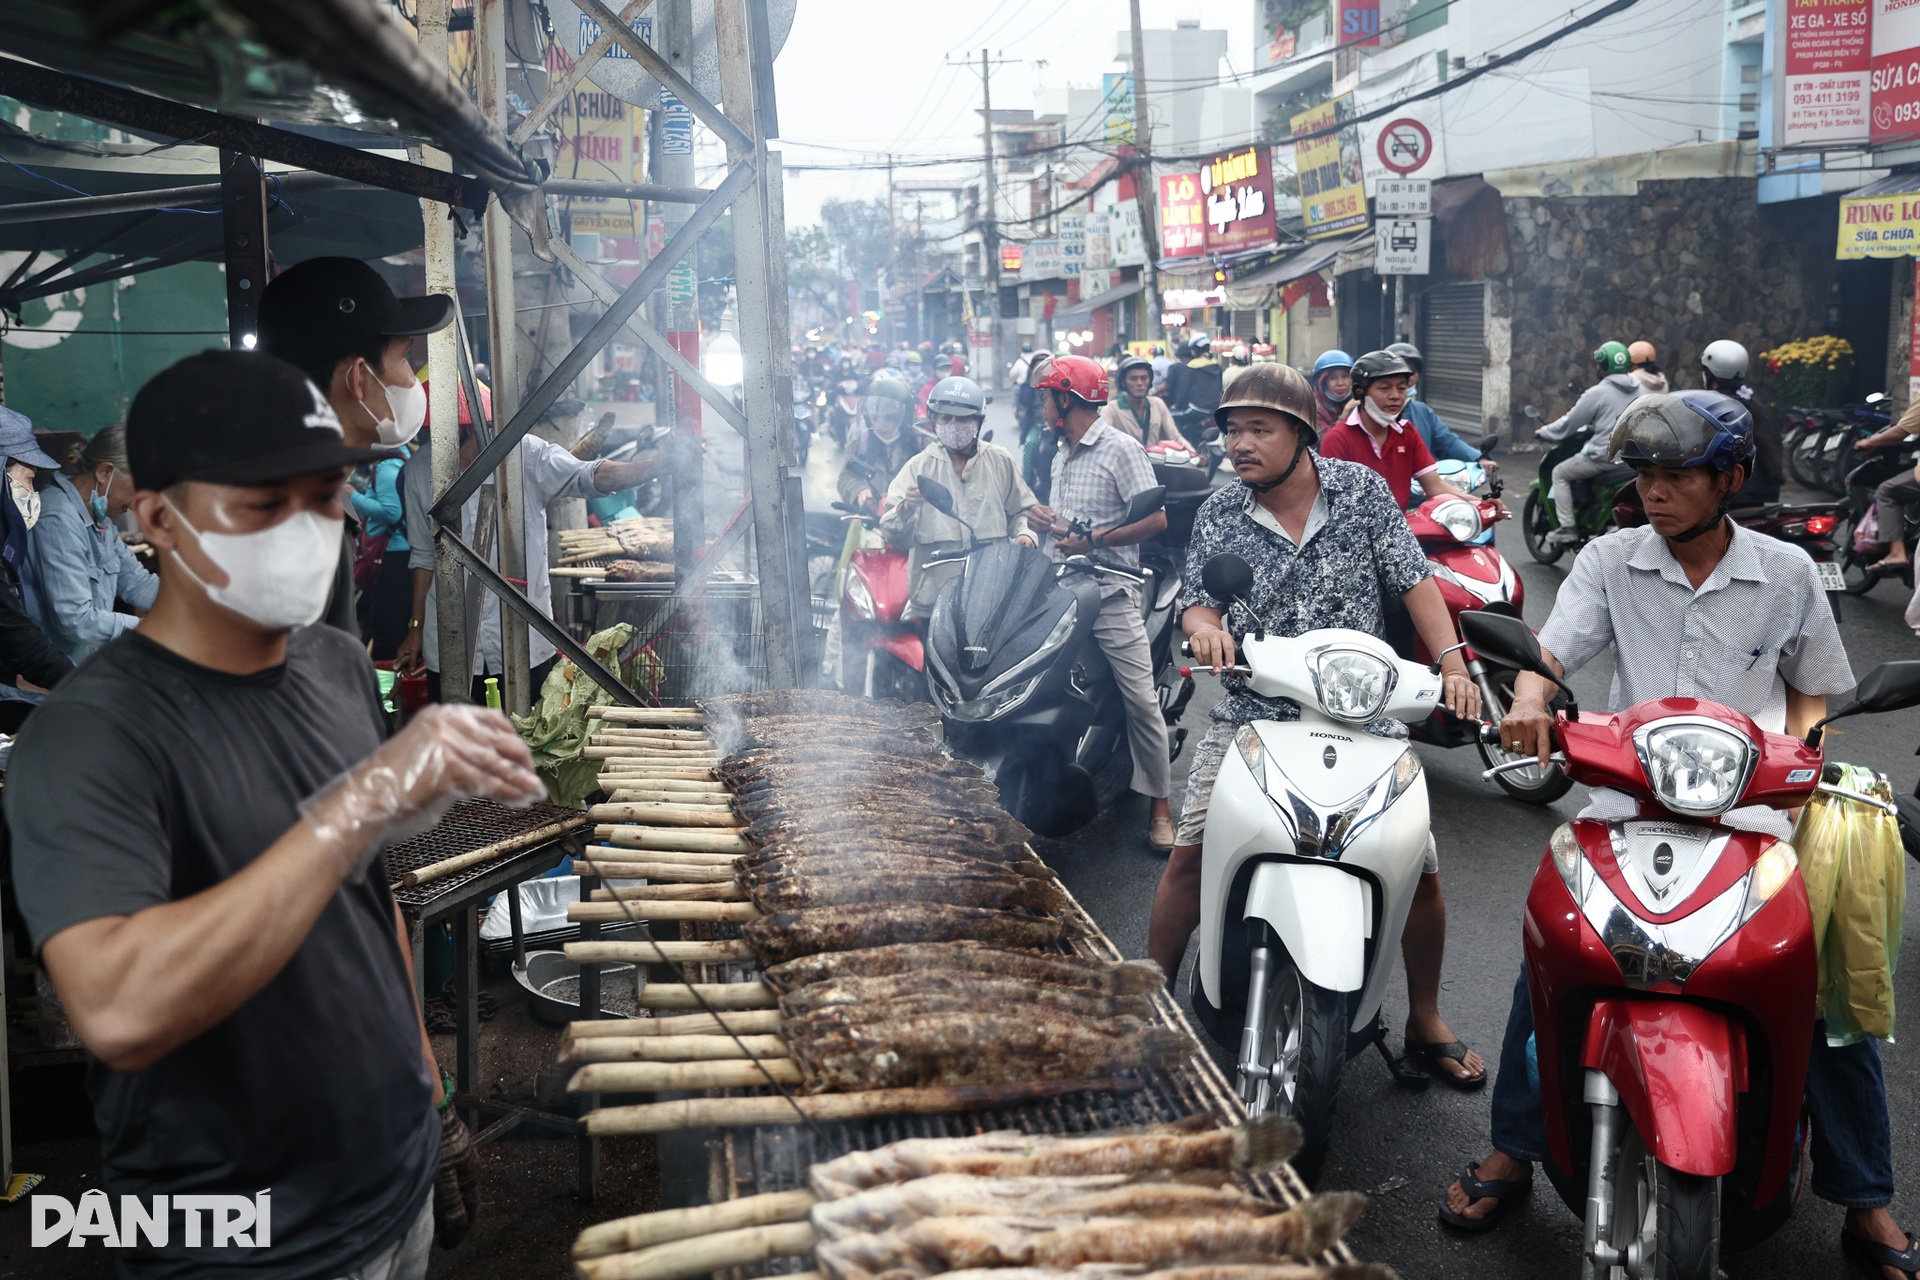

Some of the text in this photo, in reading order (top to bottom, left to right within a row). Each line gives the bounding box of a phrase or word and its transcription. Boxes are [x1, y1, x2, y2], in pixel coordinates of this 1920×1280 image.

[1791, 15, 1806, 29] XE
[1808, 14, 1825, 28] GA
[1833, 12, 1848, 27] XE
[1850, 6, 1867, 26] SỐ
[1793, 91, 1860, 105] 093 411 3199
[1309, 732, 1354, 743] HONDA
